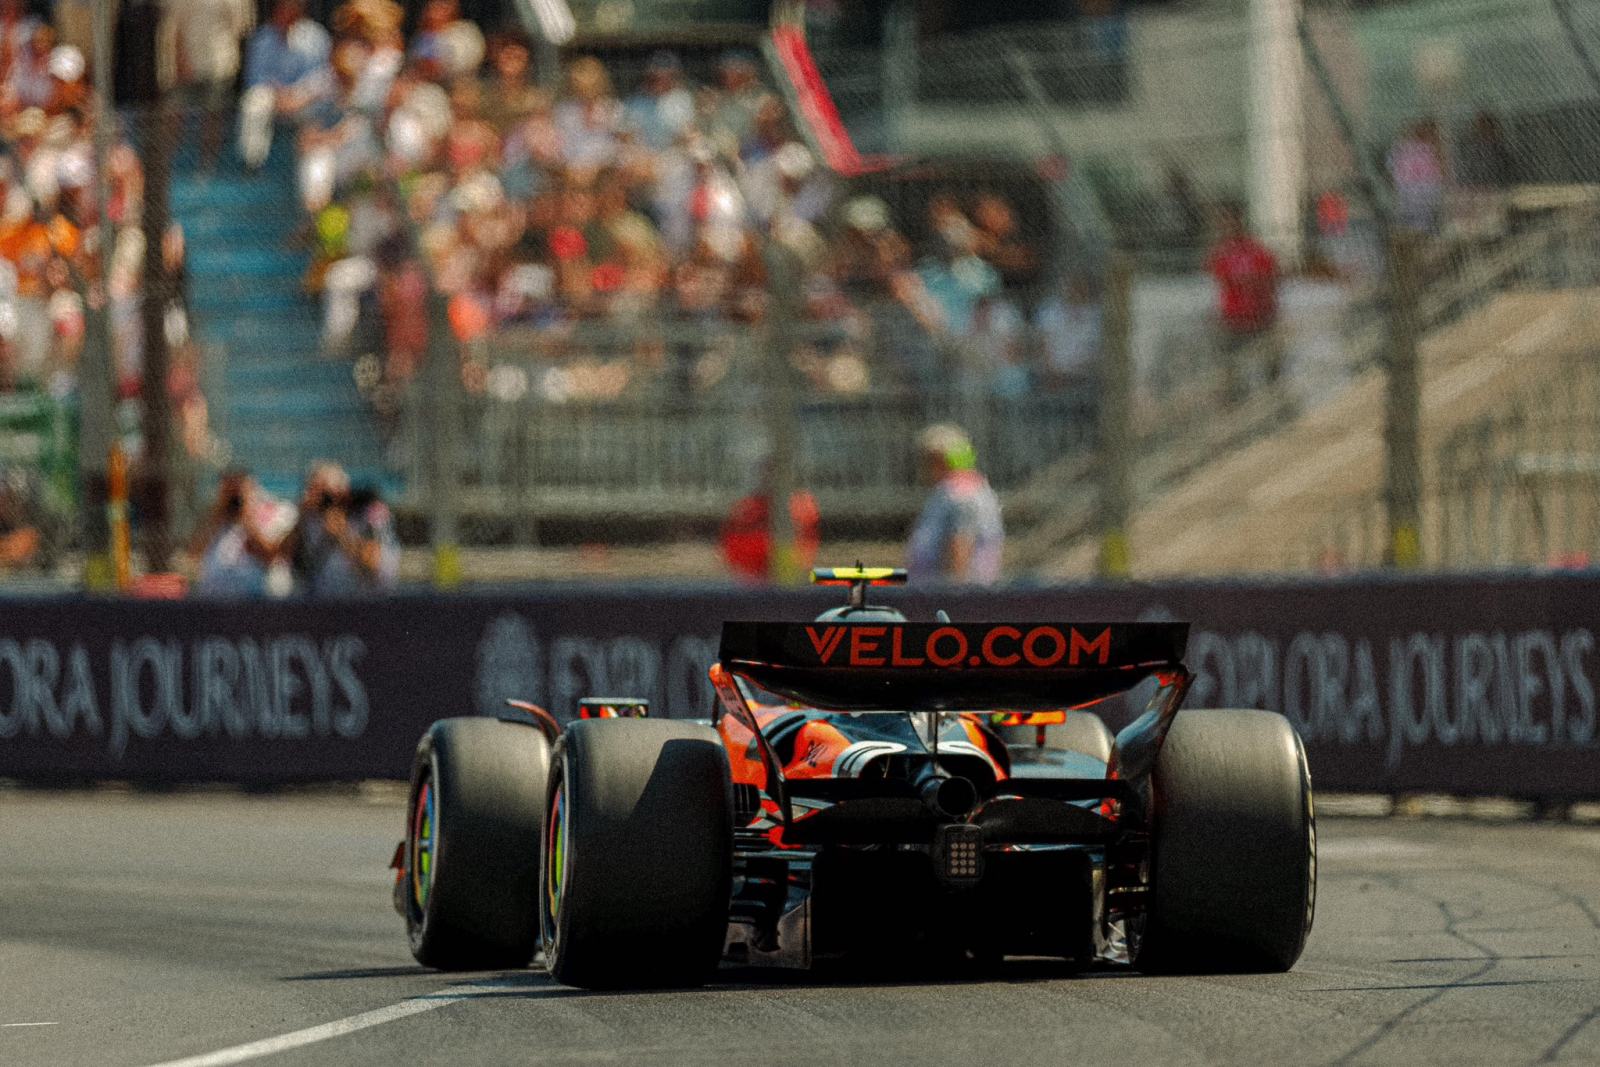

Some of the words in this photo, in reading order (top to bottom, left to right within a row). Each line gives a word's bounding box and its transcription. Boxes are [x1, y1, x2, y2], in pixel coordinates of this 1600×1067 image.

[108, 634, 370, 760] JOURNEYS
[805, 625, 1112, 666] VELO.COM
[1388, 628, 1596, 766] JOURNEYS
